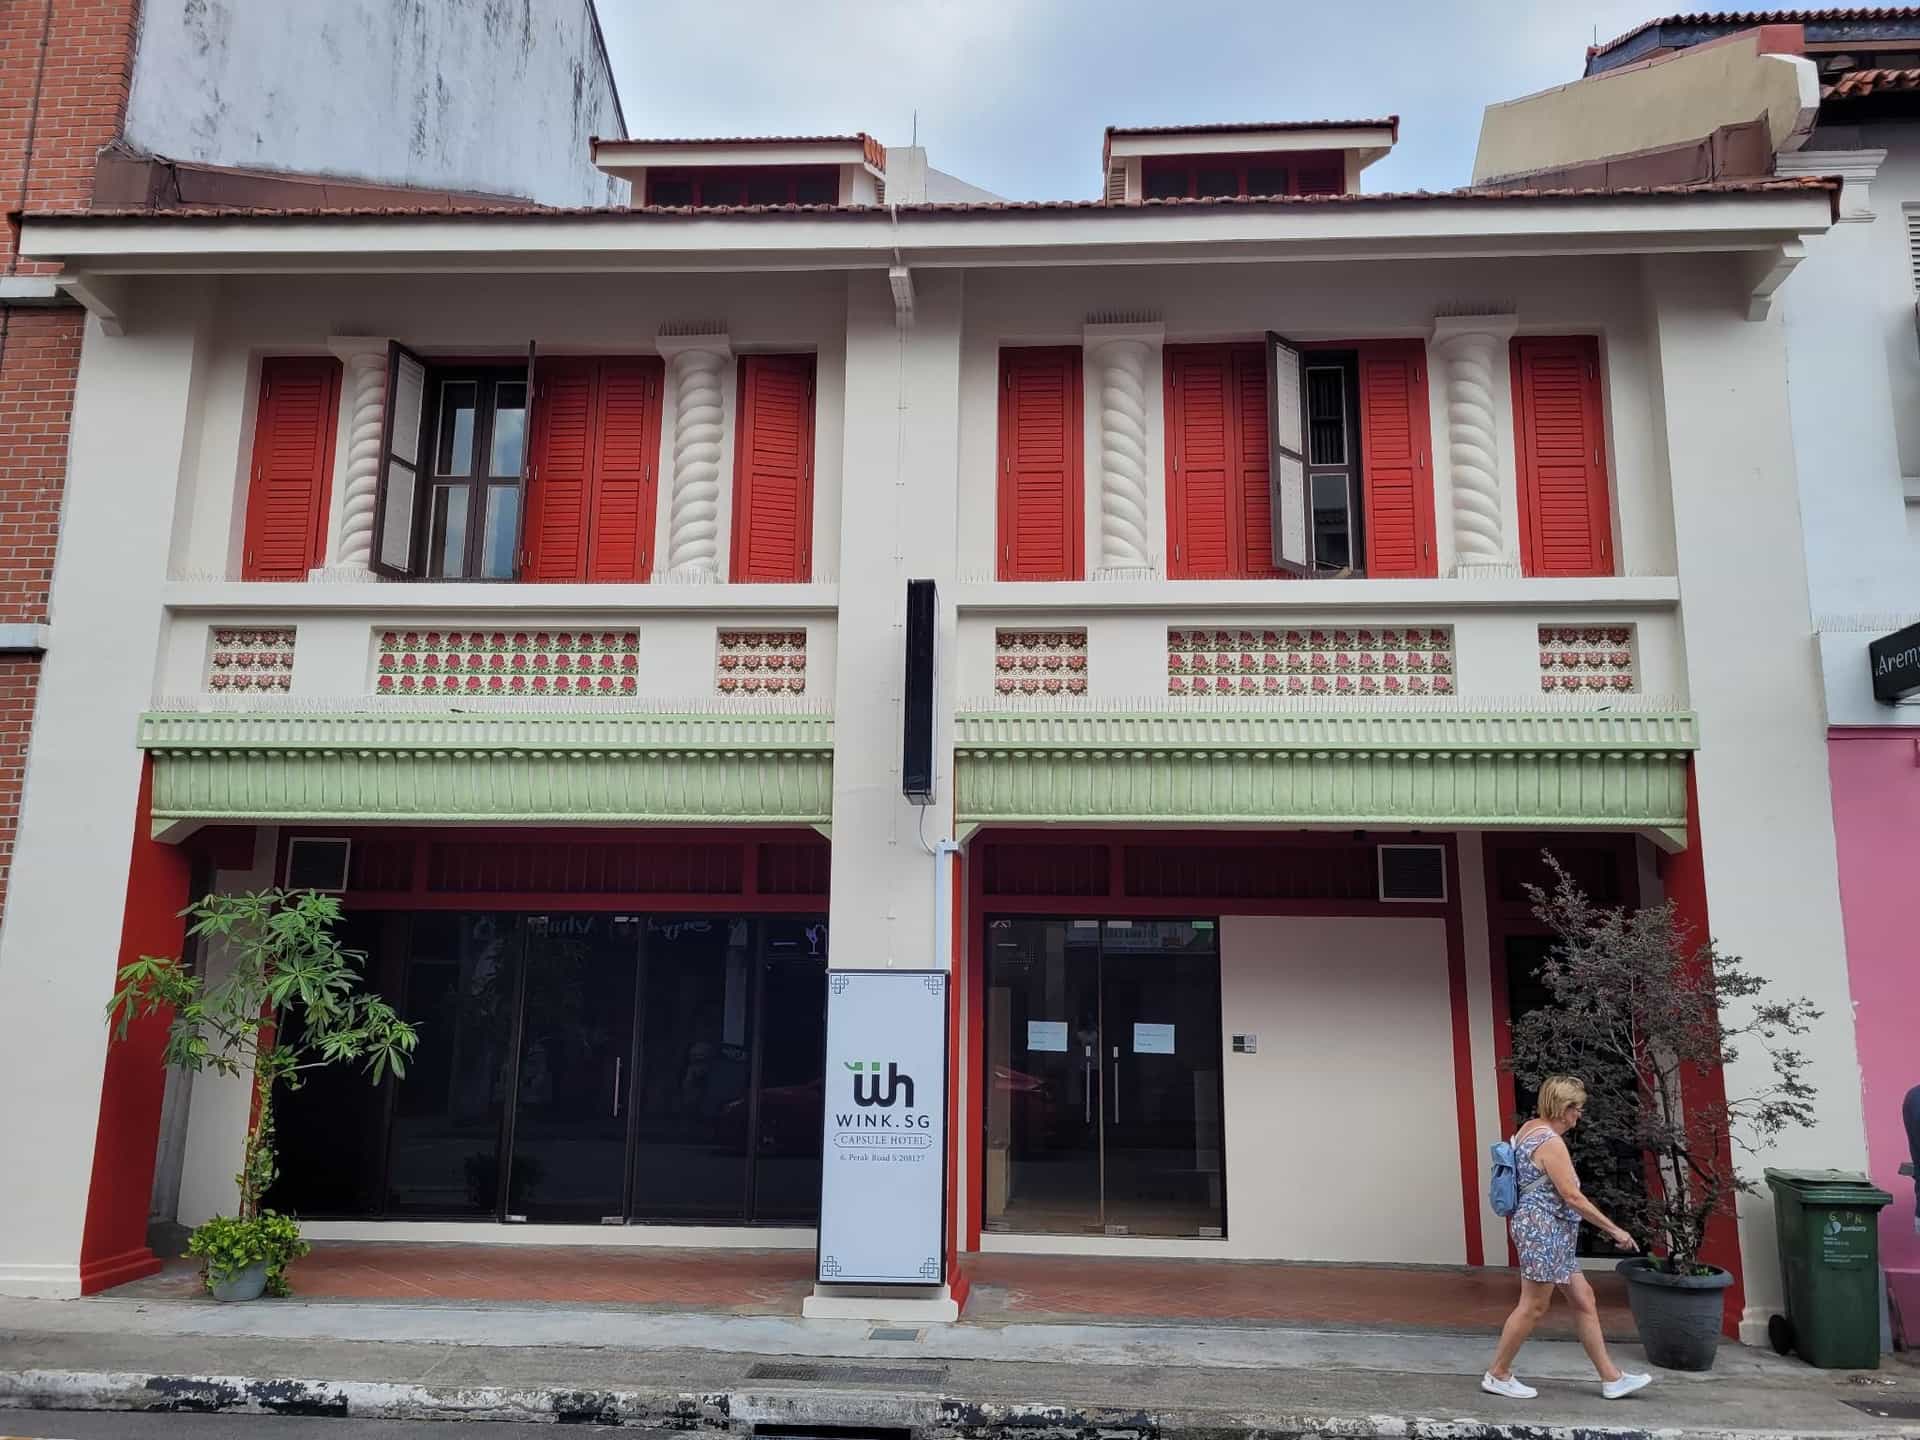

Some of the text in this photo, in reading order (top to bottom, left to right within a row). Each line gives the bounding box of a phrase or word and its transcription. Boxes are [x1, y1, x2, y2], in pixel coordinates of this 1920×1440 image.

[836, 1114, 930, 1128] WINK.SG
[840, 1135, 926, 1145] CAPSULE HOTEL
